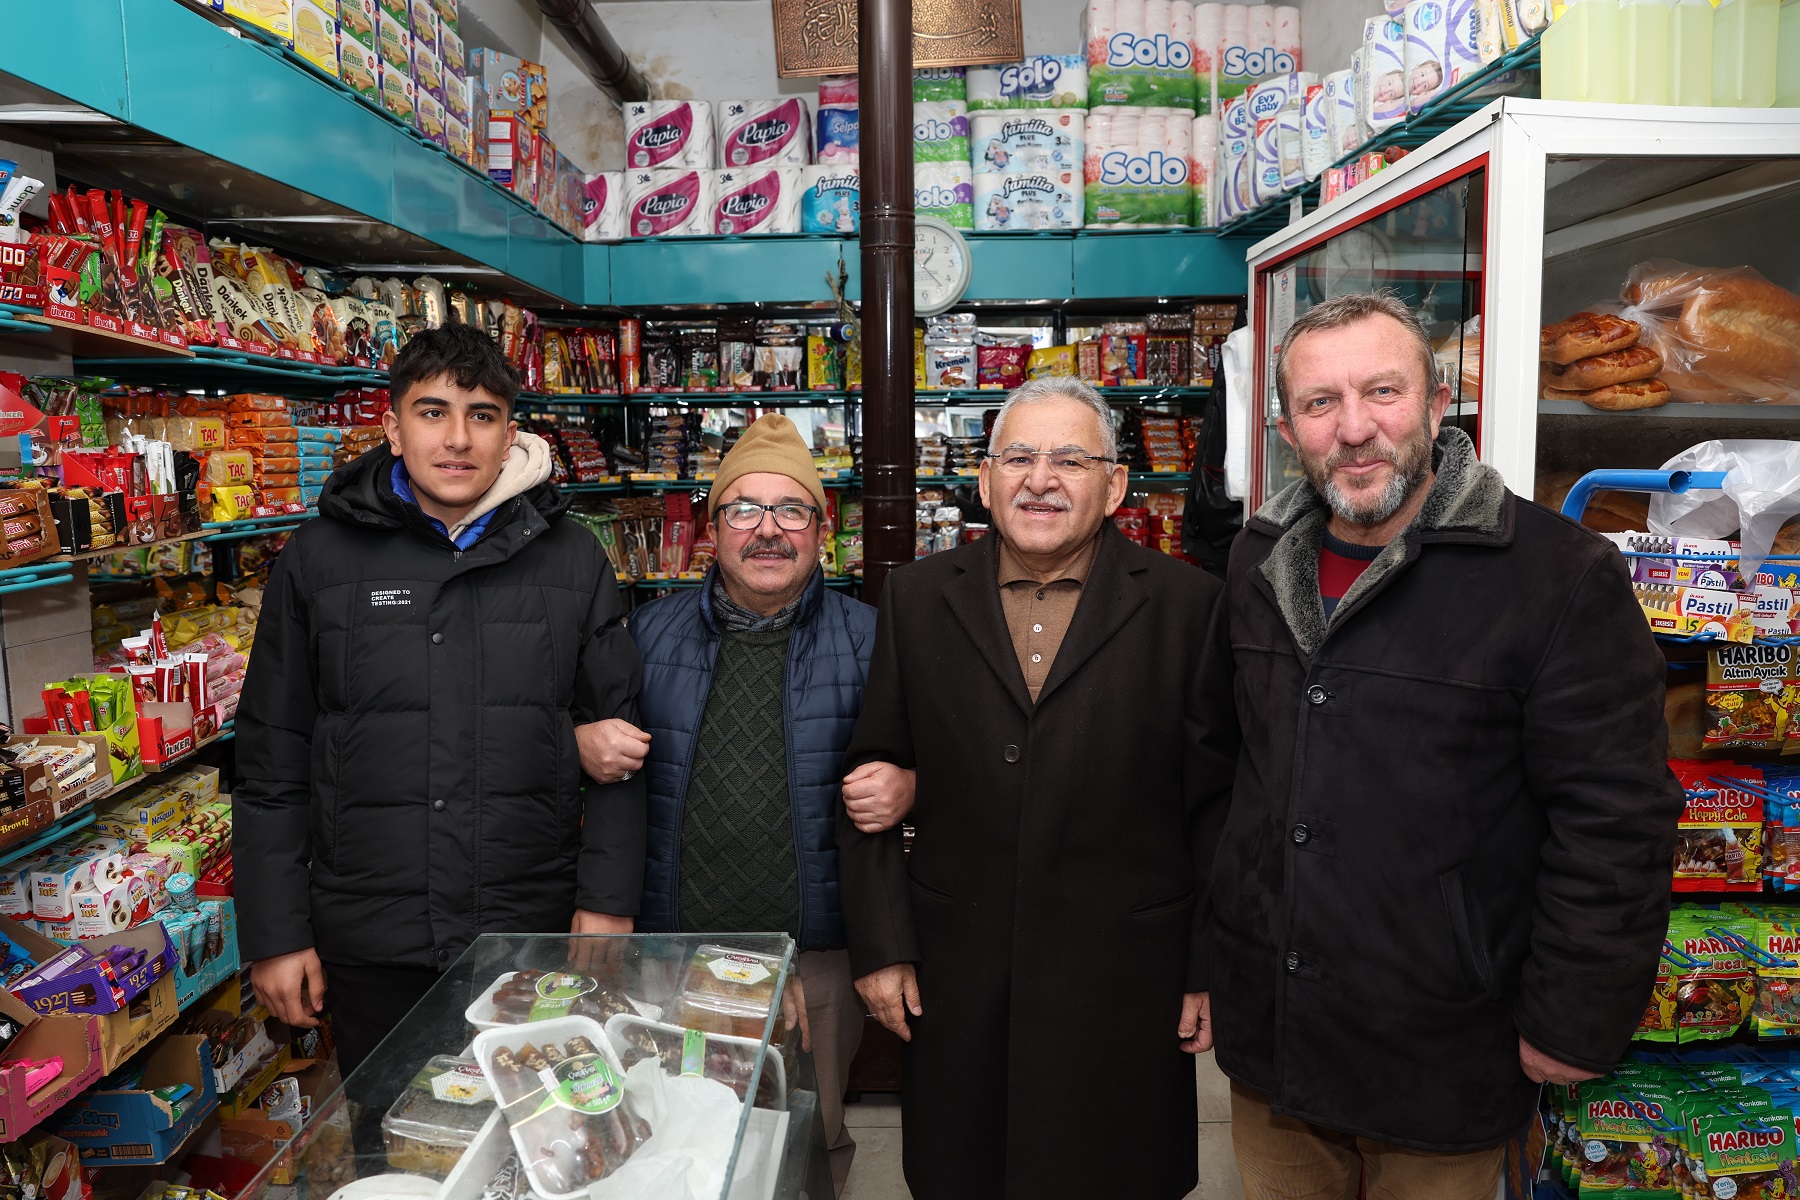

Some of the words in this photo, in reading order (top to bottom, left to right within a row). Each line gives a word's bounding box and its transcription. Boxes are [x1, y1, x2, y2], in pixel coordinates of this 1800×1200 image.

[1504, 0, 1514, 28] EKONOM
[1108, 32, 1191, 69] Solo
[1223, 46, 1295, 77] Solo
[1000, 58, 1061, 95] Solo
[1255, 101, 1279, 114] Baby
[1258, 93, 1275, 105] Evy
[632, 107, 638, 116] 3
[728, 106, 735, 116] 3
[641, 124, 681, 147] Papia
[744, 119, 789, 145] Papia
[833, 121, 859, 134] Selpa
[912, 119, 953, 141] olo
[1002, 118, 1053, 143] familia
[1055, 136, 1062, 146] 3
[1100, 150, 1187, 186] Solo
[637, 175, 643, 185] 3
[719, 174, 727, 184] 3
[815, 173, 860, 197] famili
[1003, 175, 1054, 199] familia
[645, 193, 688, 216] Papia
[725, 194, 768, 216] Papia
[915, 233, 925, 242] 12
[943, 246, 950, 254] 2
[948, 259, 955, 268] 3
[945, 274, 951, 282] 4
[172, 278, 193, 314] Dankek
[217, 284, 249, 321] Dankek
[921, 289, 929, 299] 6
[50, 305, 76, 320] ÜLKER
[201, 428, 218, 444] TAÇ
[228, 463, 245, 479] TAÇ
[234, 495, 251, 509] TAÇ
[1678, 570, 1690, 578] YENİ
[1757, 573, 1775, 586] IBO
[1700, 578, 1724, 588] Pastil
[371, 589, 401, 597] DESIGNED
[1685, 598, 1733, 616] Pastil
[1757, 598, 1789, 611] astil
[1685, 618, 1700, 632] 15
[1718, 644, 1791, 666] HARIBO
[1723, 667, 1752, 679] Altın
[1753, 665, 1787, 680] Ayıcık
[1, 814, 29, 834] Browni
[151, 806, 176, 826] Nesquik
[37, 880, 58, 888] kinder
[1768, 935, 1800, 955] HAR
[33, 991, 69, 1013] 1927
[233, 1052, 245, 1072] 3
[1588, 1099, 1664, 1121] HARIBO
[82, 1110, 120, 1130] Star
[1593, 1118, 1653, 1135] Phantasia
[1707, 1126, 1785, 1153] HARIBO
[1719, 1148, 1779, 1168] Phantasia
[1715, 1178, 1731, 1188] Yeni
